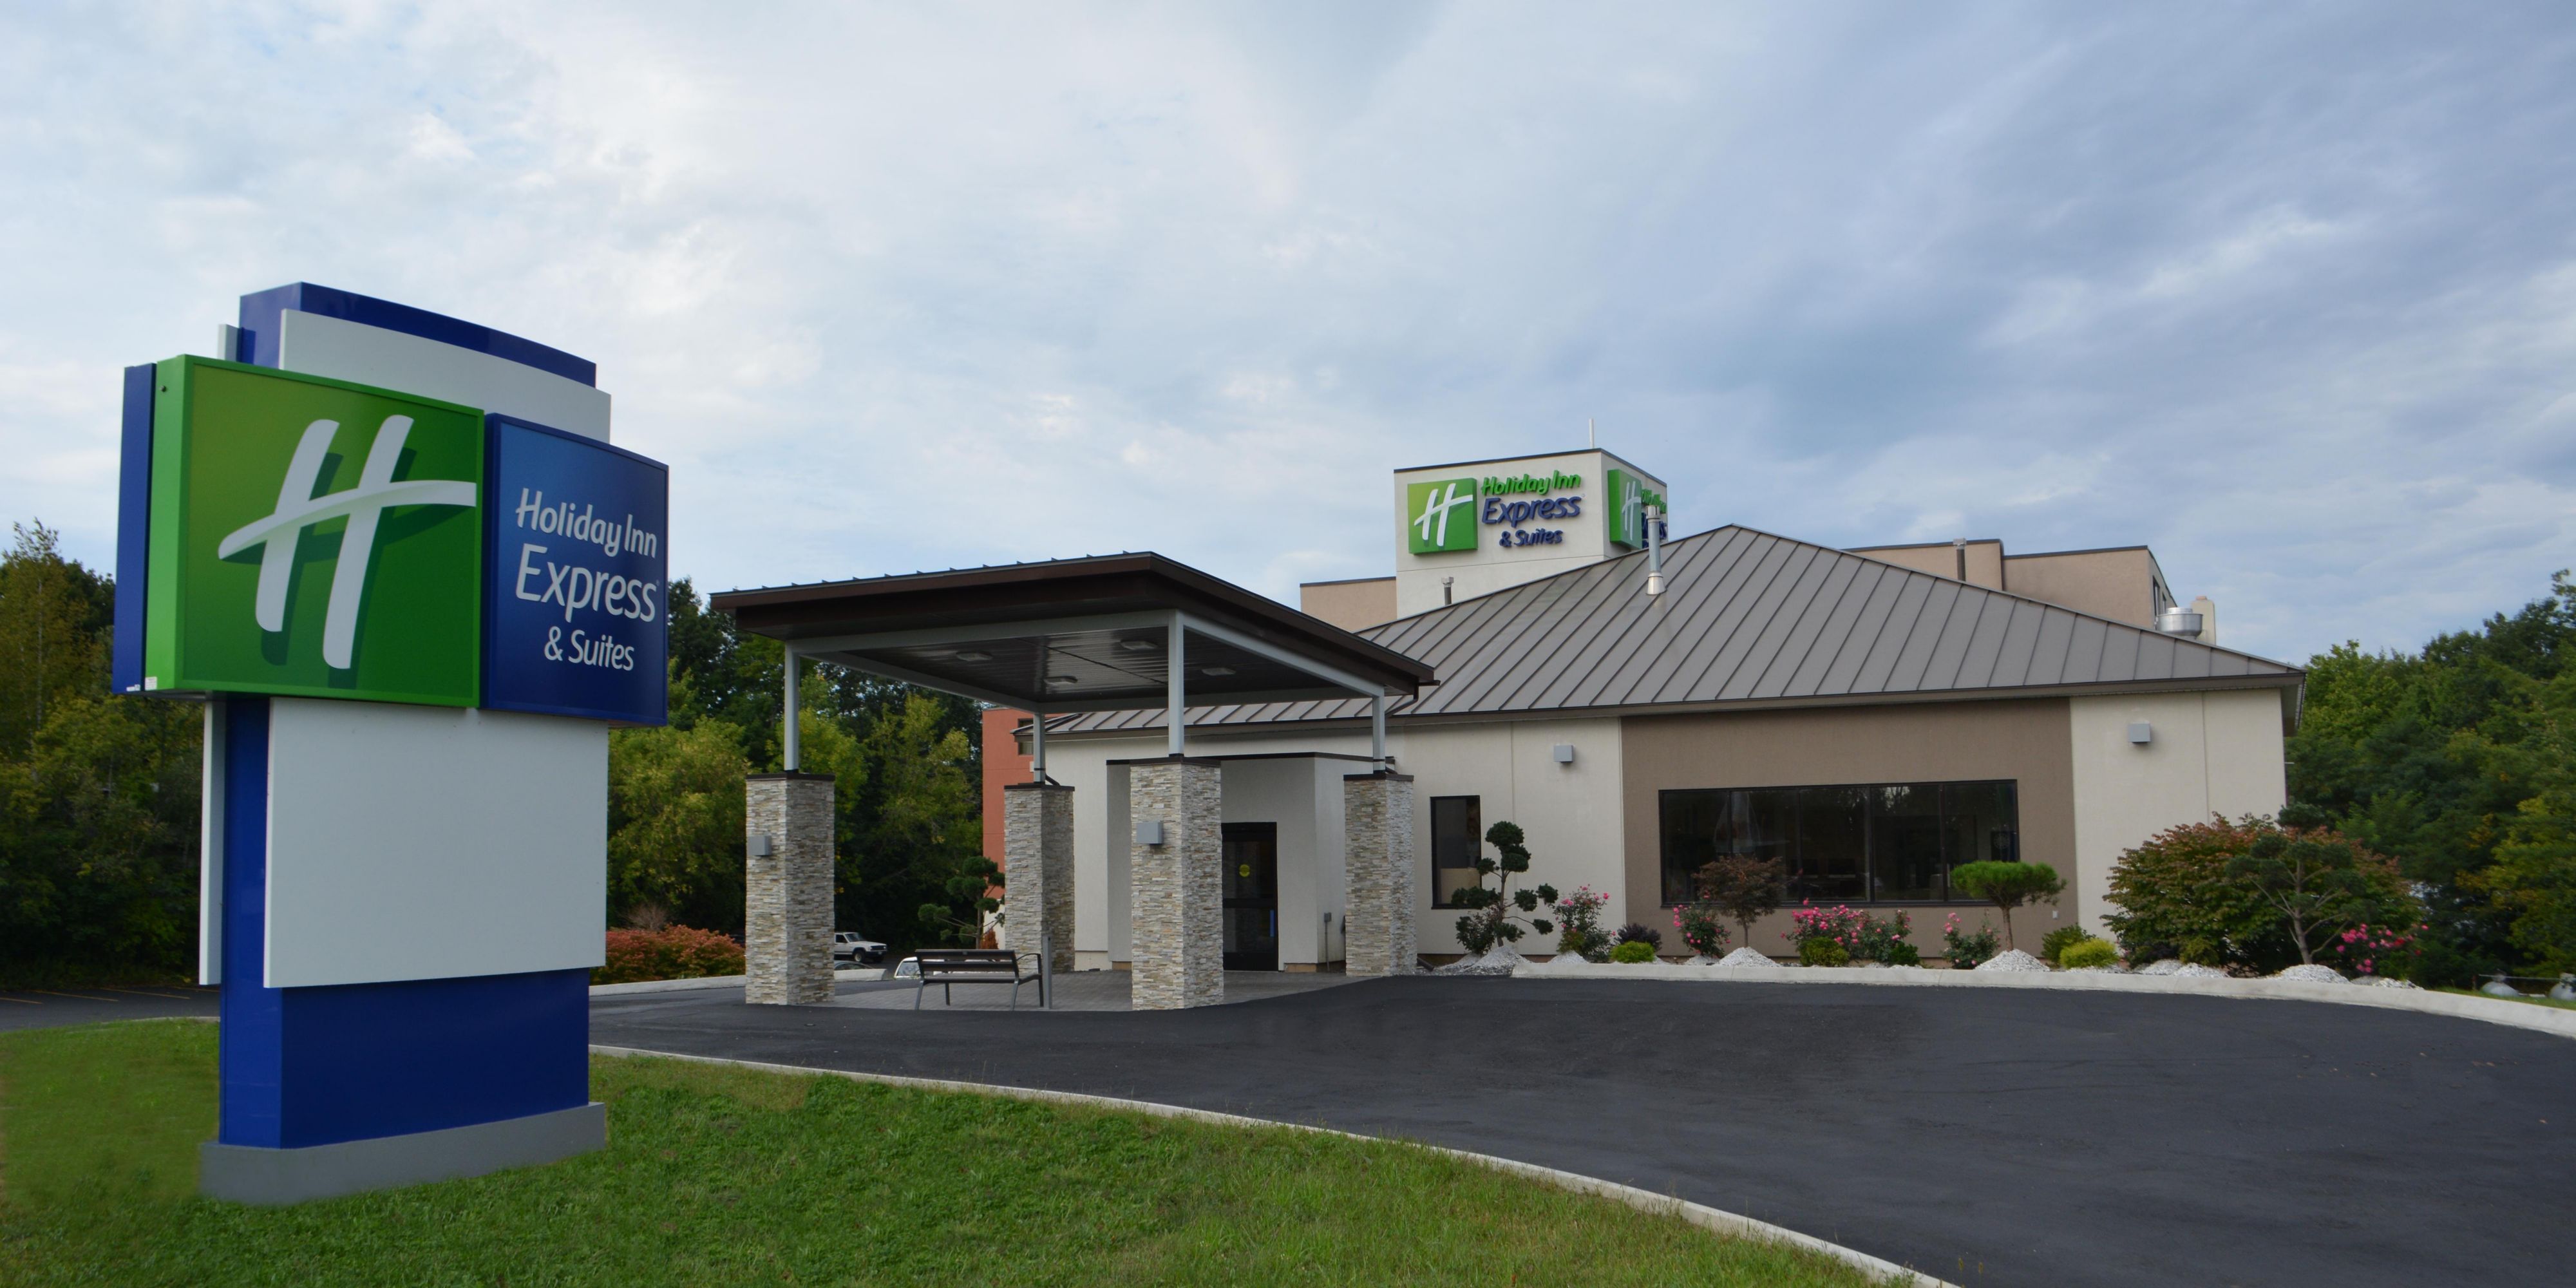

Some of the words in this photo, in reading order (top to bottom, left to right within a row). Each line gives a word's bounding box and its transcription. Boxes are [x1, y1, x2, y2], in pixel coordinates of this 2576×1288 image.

[1481, 473, 1551, 496] Holiday
[1552, 469, 1581, 489] Inn
[516, 488, 622, 557] Holiday
[624, 513, 658, 558] Inn
[1482, 496, 1582, 528] Express
[1499, 531, 1512, 547] &
[1514, 528, 1563, 547] Suites
[516, 543, 657, 623] Express
[544, 626, 563, 661] &
[568, 629, 634, 671] Suites
